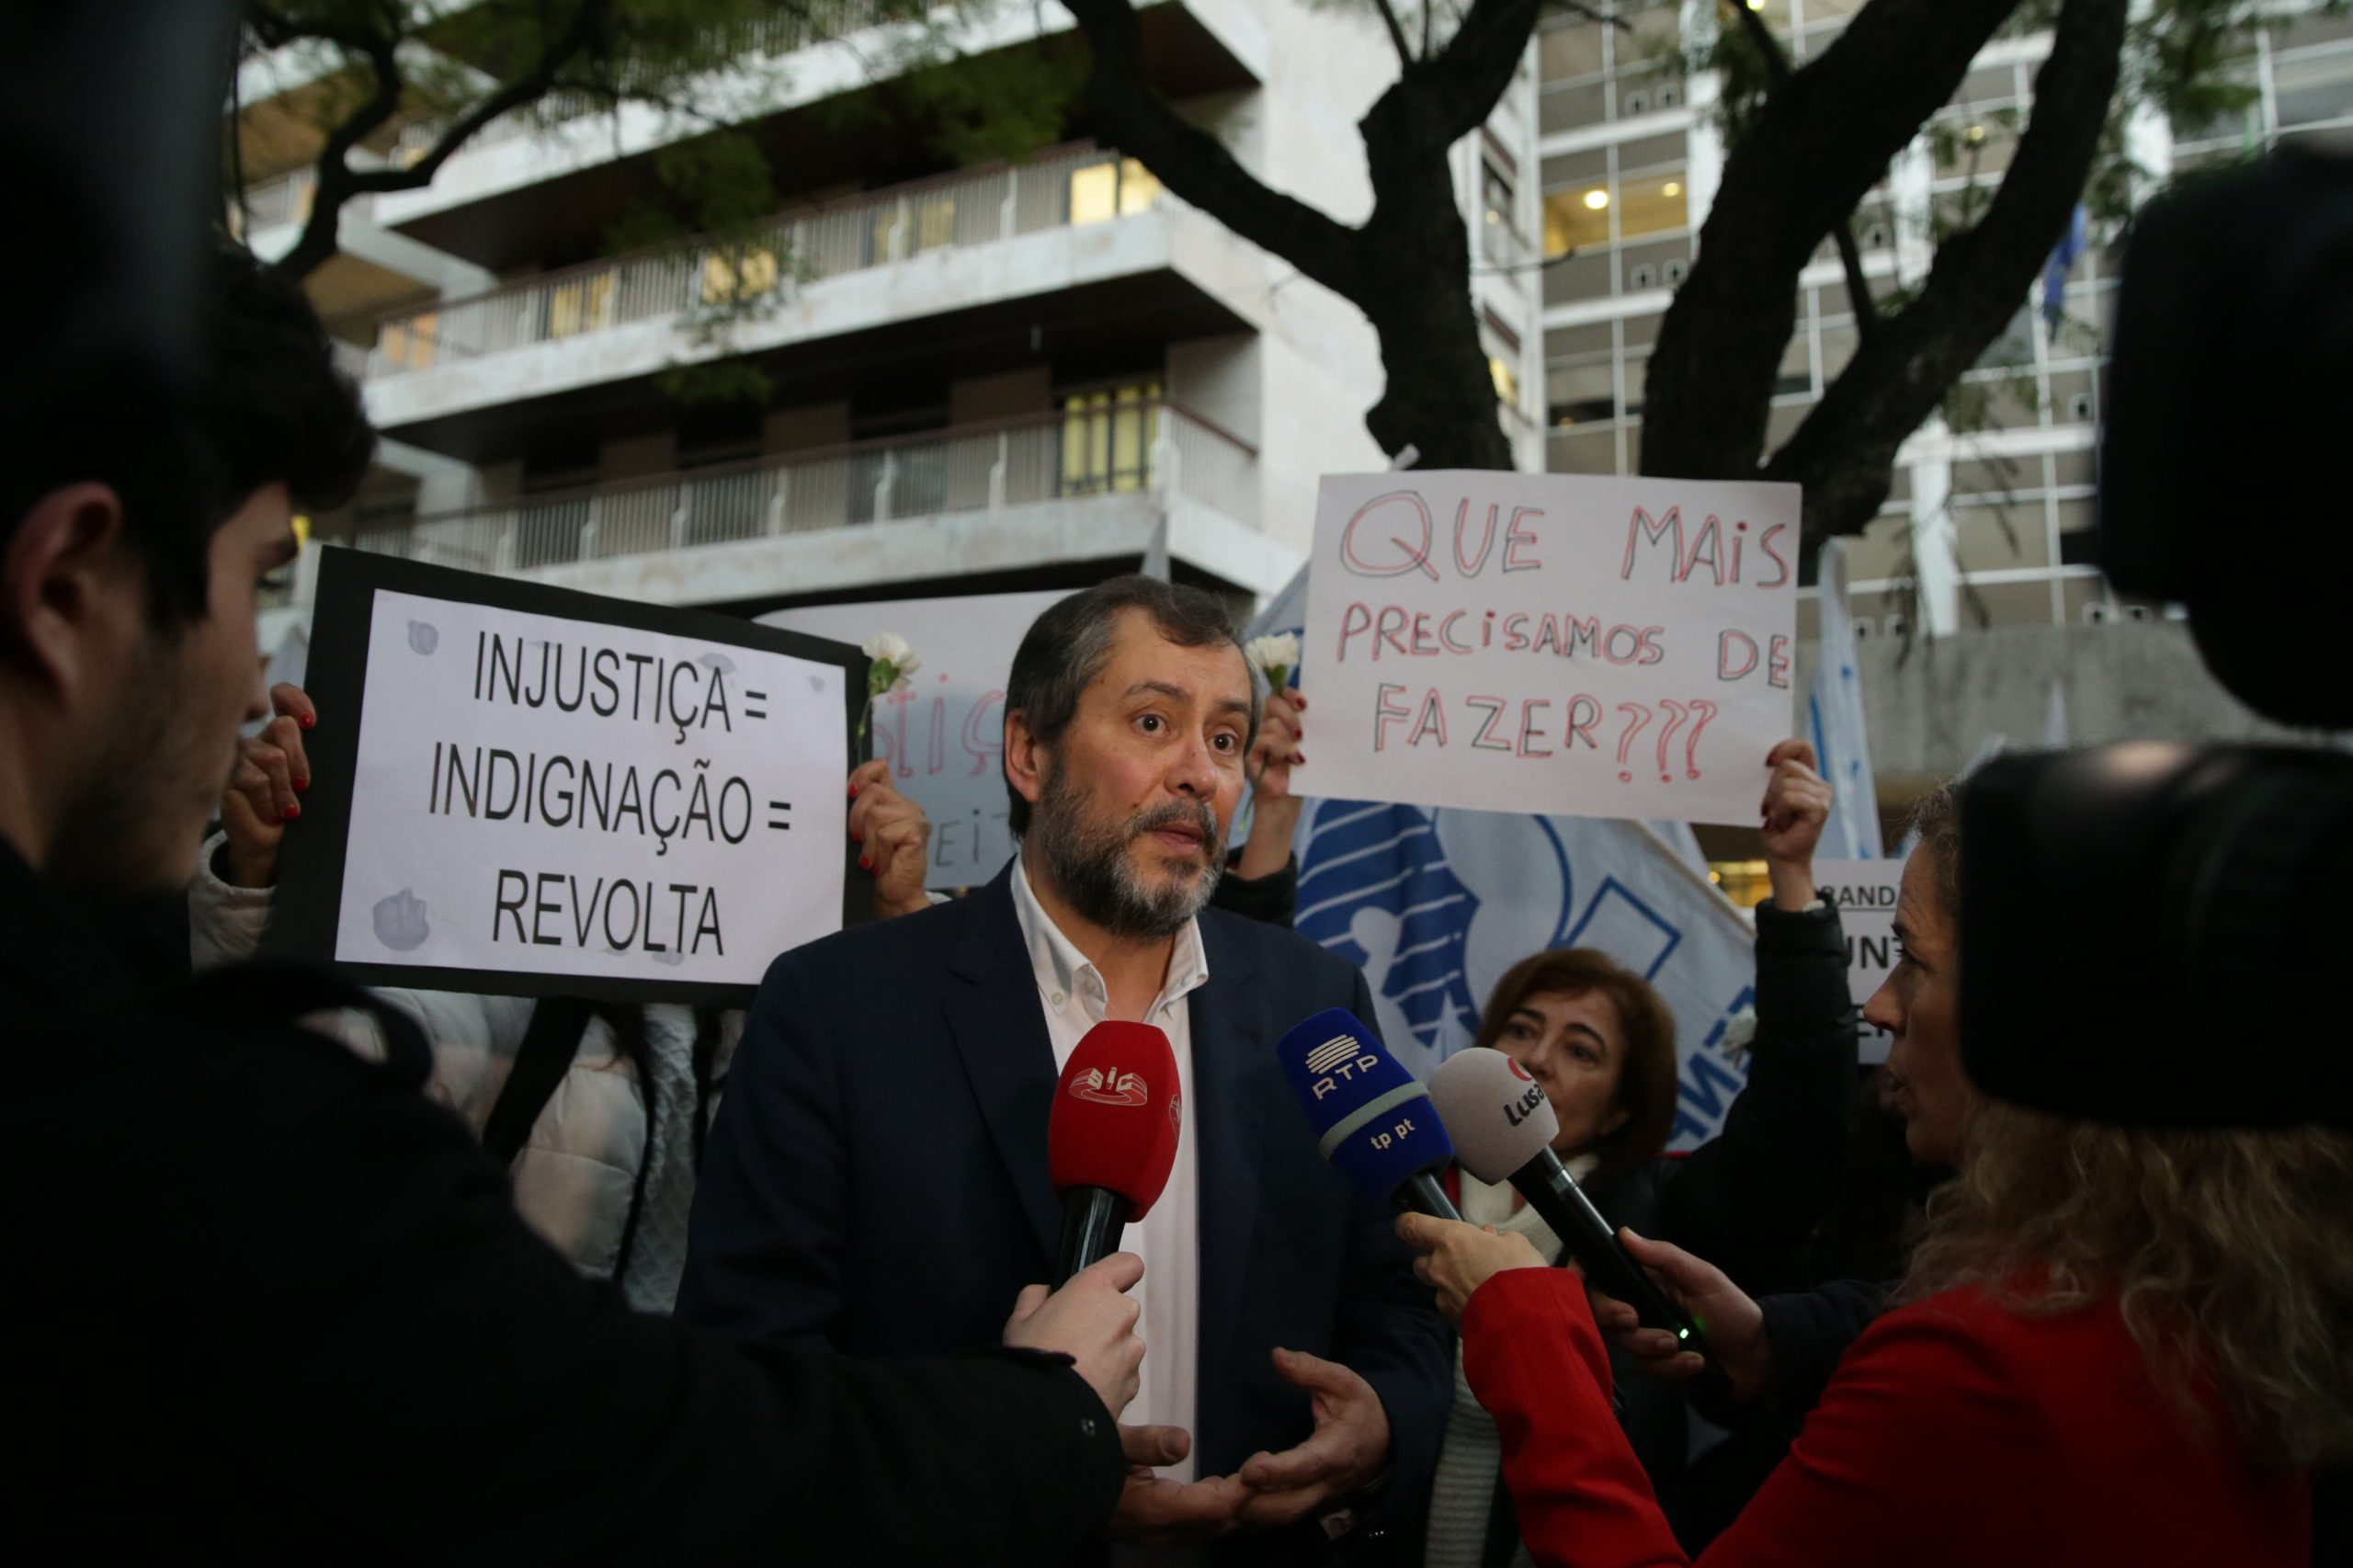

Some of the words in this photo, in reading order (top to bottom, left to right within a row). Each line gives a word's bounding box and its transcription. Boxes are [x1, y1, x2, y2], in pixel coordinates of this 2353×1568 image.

[1339, 490, 1546, 582] QUE
[473, 630, 732, 744] INJUSTIÇA
[1717, 629, 1790, 689] DE
[1374, 683, 1719, 782] FAZER???
[429, 742, 752, 857] INDIGNAÇÃO
[492, 869, 724, 956] REVOLTA
[1312, 1054, 1379, 1100] RTP
